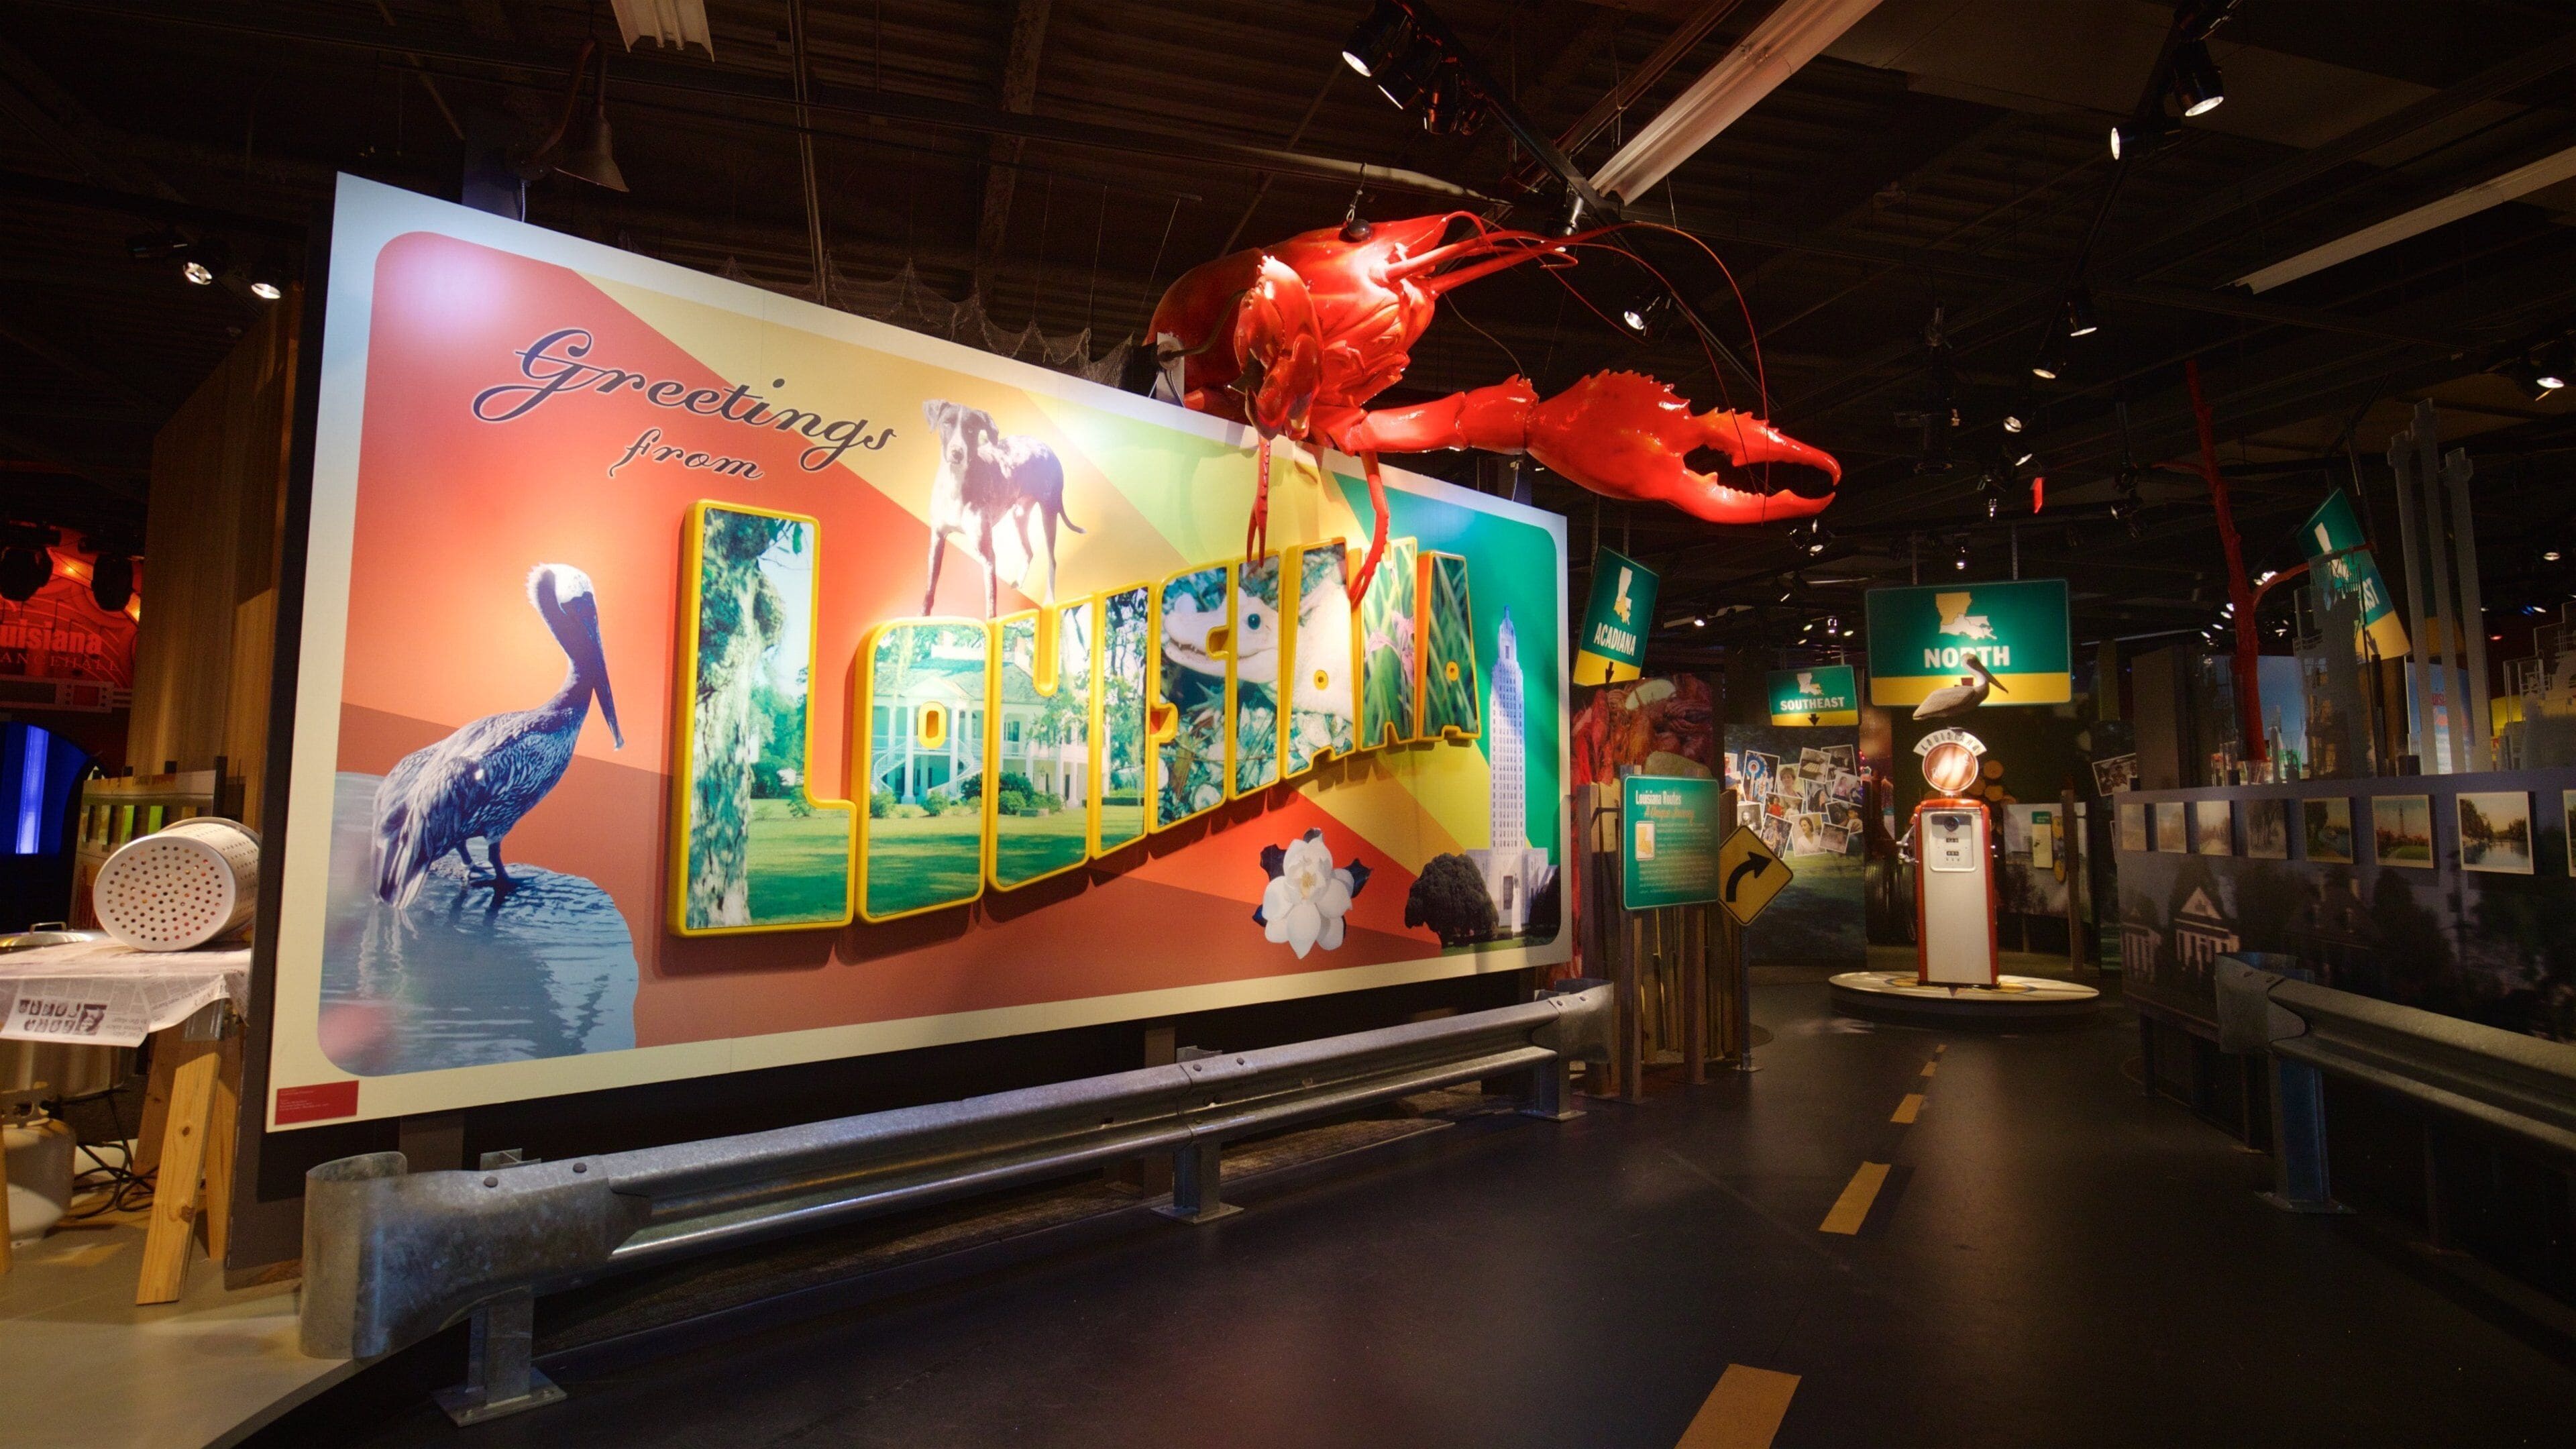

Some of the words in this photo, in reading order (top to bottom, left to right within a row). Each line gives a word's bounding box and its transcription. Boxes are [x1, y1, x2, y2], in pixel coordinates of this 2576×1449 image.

[472, 327, 897, 472] Greetings
[608, 428, 763, 480] from
[1593, 622, 1637, 657] ACADIANA
[676, 500, 1481, 936] LOUISIANA
[1780, 696, 1845, 711] SOUTHEAST
[1635, 790, 1662, 805] Louisiana
[1663, 790, 1682, 805] Routes
